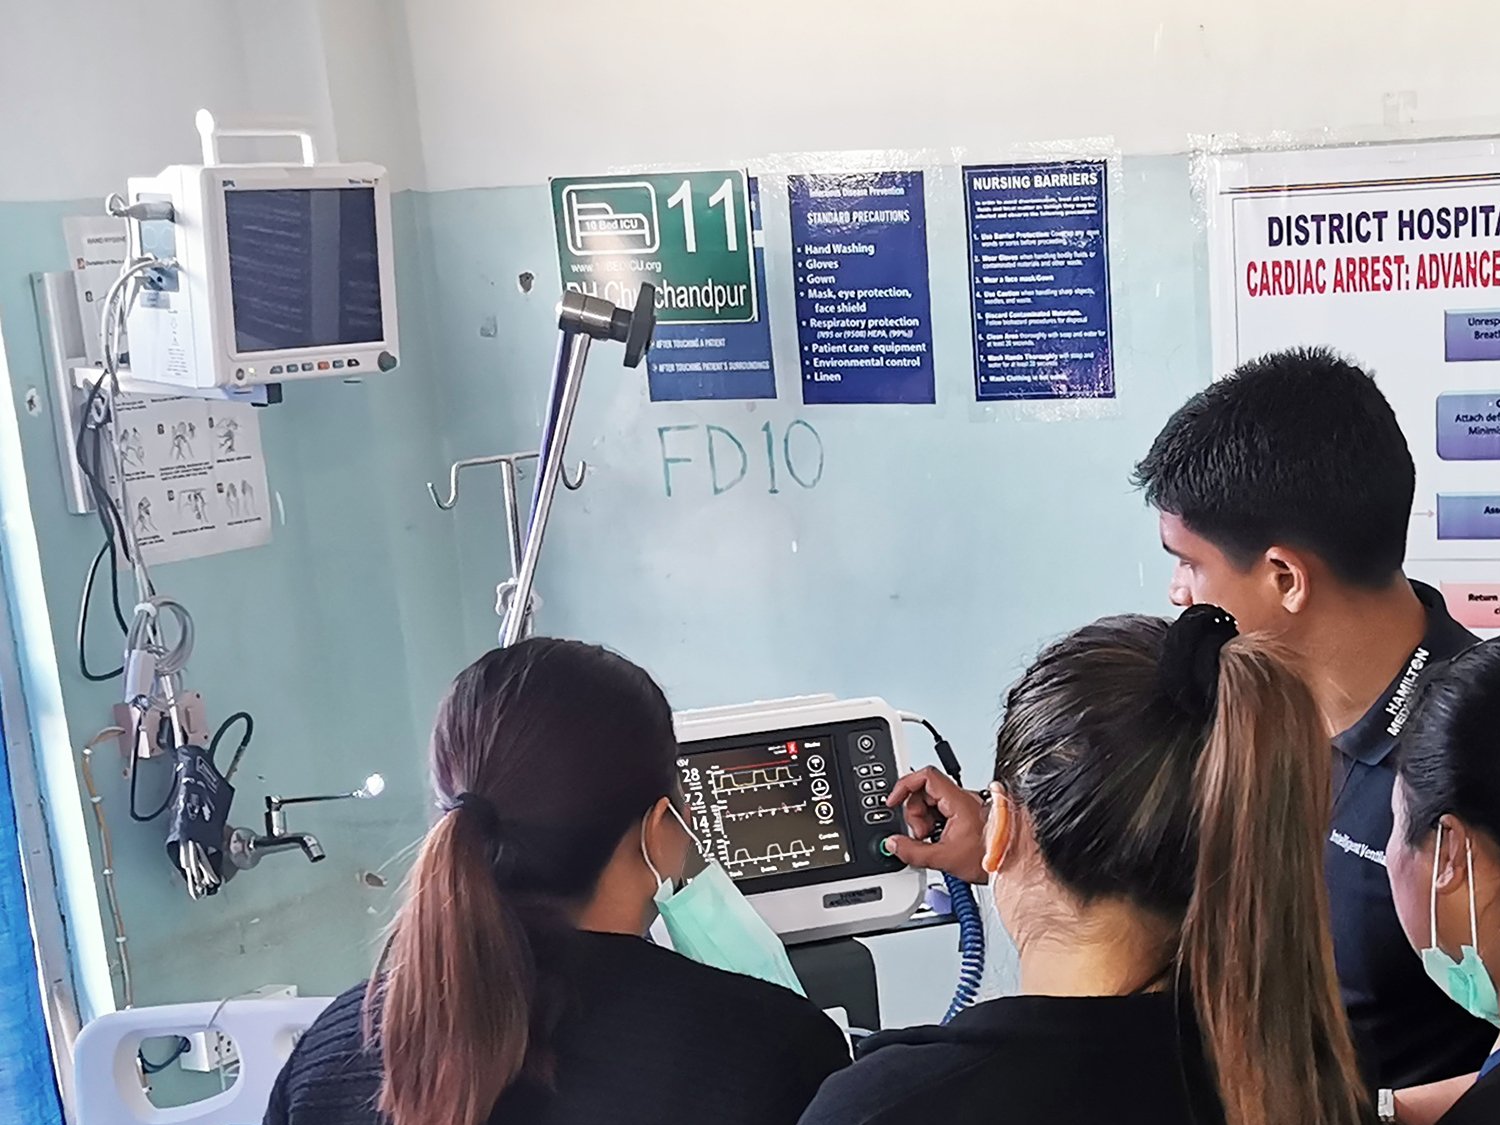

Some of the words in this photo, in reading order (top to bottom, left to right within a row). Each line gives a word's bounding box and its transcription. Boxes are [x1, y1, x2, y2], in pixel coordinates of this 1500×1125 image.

[973, 176, 1031, 190] NURSING
[1033, 173, 1098, 188] BARRIERS
[667, 178, 738, 252] 11
[807, 210, 850, 225] STANDARD
[852, 209, 910, 223] PRECAUTIONS
[620, 218, 638, 229] ICU
[1267, 210, 1388, 247] DISTRICT
[805, 244, 831, 255] Hand
[832, 243, 875, 256] Washing
[805, 259, 839, 270] Gloves
[806, 273, 836, 284] Gown
[1246, 258, 1326, 297] CARDIAC
[1332, 254, 1410, 294] ARREST:
[808, 288, 836, 299] Mask,
[838, 290, 855, 300] eye
[857, 287, 912, 299] protection,
[815, 303, 835, 313] face
[837, 302, 867, 313] shield
[810, 317, 866, 330] Respiratory
[868, 316, 920, 329] protection
[812, 343, 847, 353] Patient
[848, 344, 869, 353] care
[872, 341, 926, 354] equipment
[813, 356, 884, 368] Environmental
[885, 356, 921, 367] control
[814, 371, 842, 382] Linen
[1455, 413, 1484, 423] Attach
[1468, 593, 1498, 602] Return
[1385, 647, 1430, 716] HAMILTON
[682, 767, 700, 783] 28
